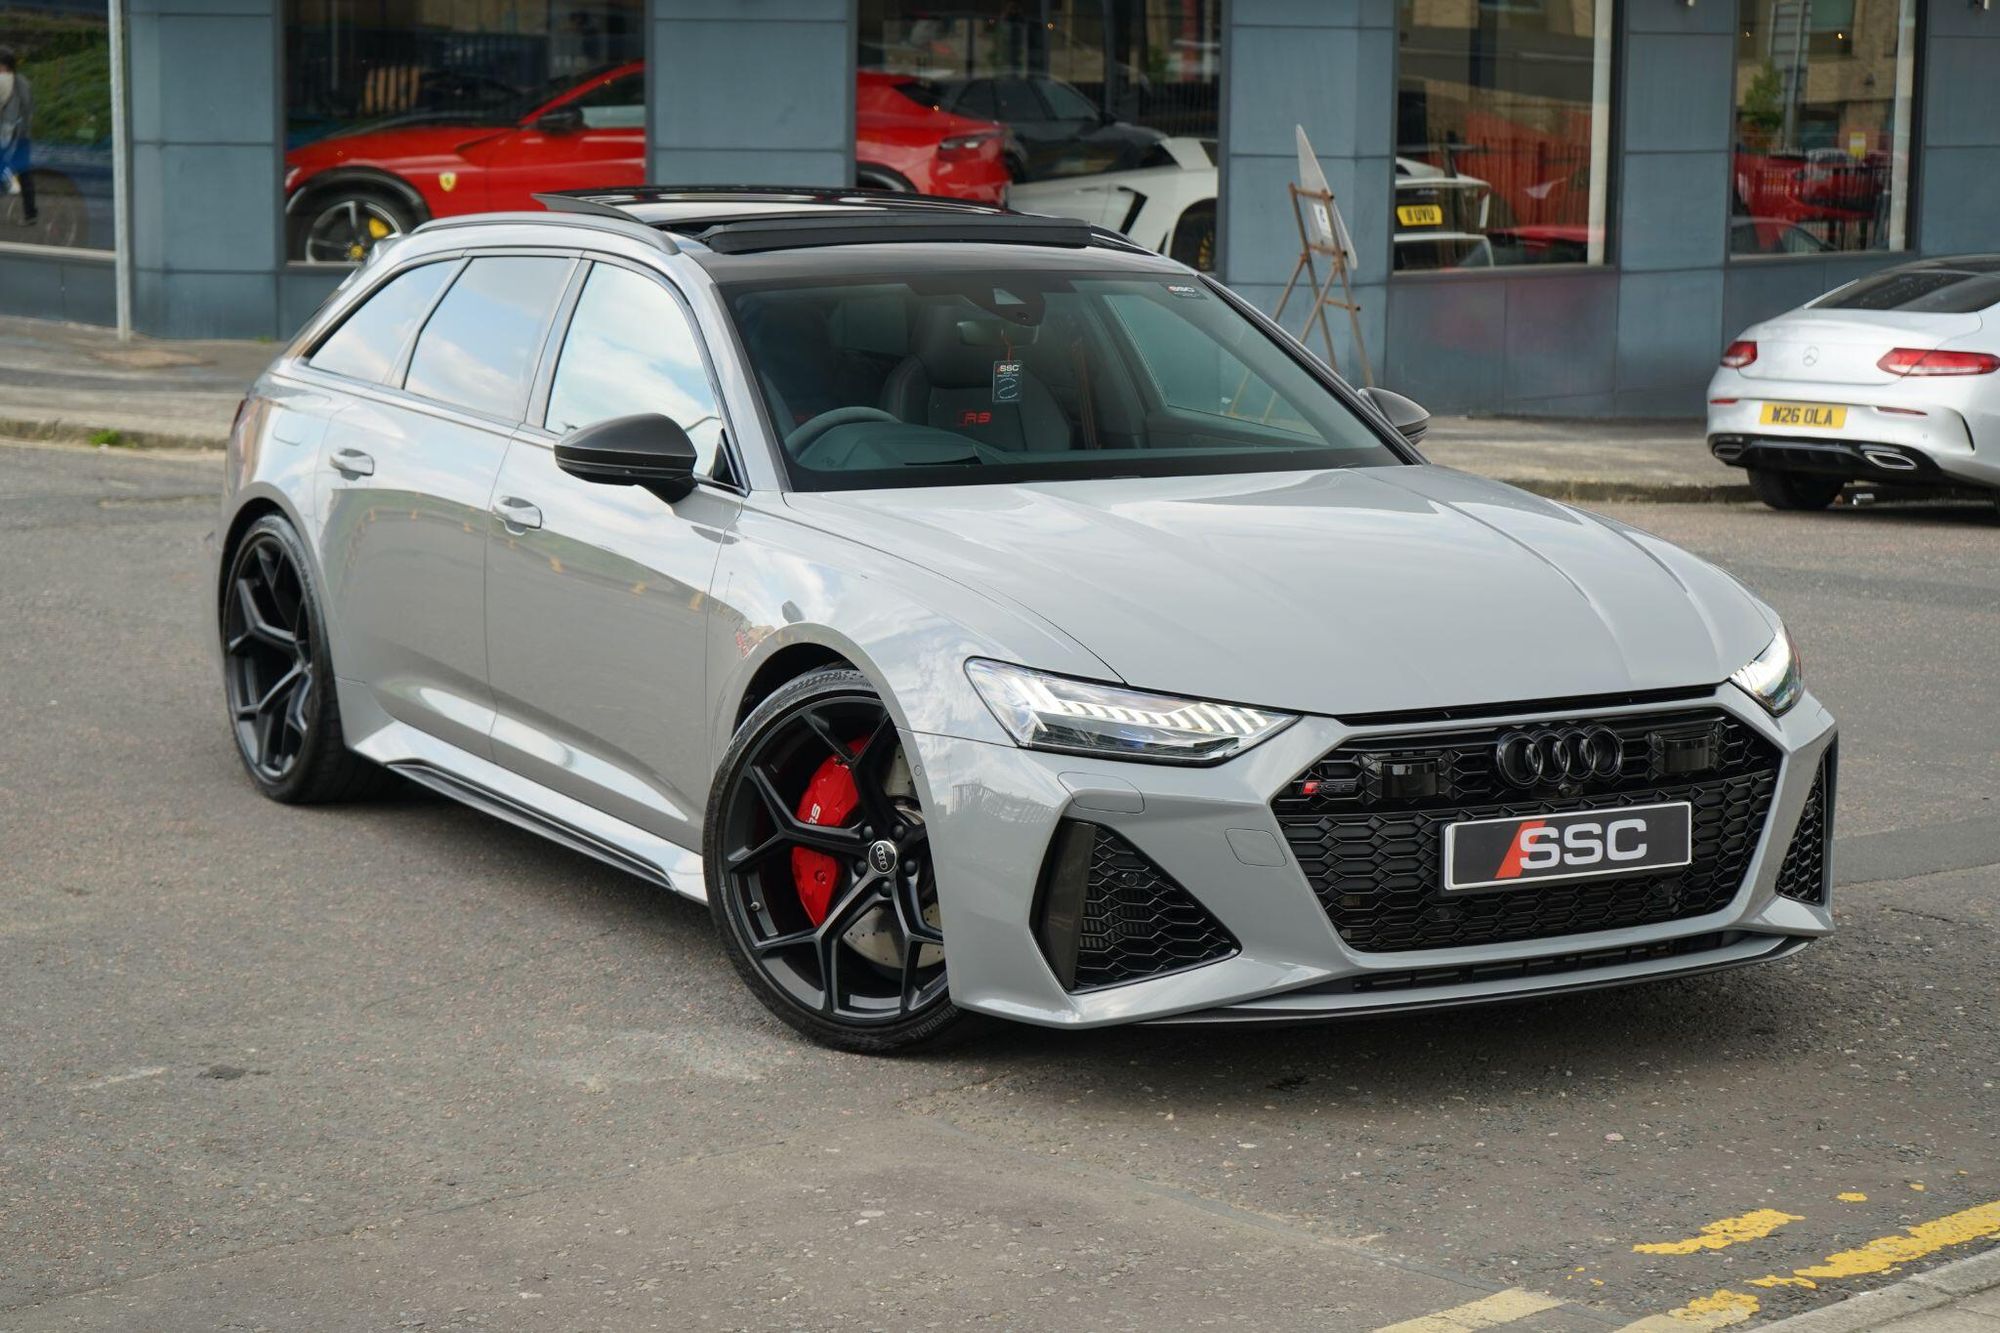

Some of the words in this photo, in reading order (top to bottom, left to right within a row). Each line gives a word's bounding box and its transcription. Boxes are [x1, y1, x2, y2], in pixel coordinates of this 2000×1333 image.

[965, 412, 992, 425] RS
[1772, 405, 1800, 423] W26
[1803, 407, 1832, 425] OLA
[1519, 818, 1648, 870] SSC
[915, 1003, 959, 1038] tinental
